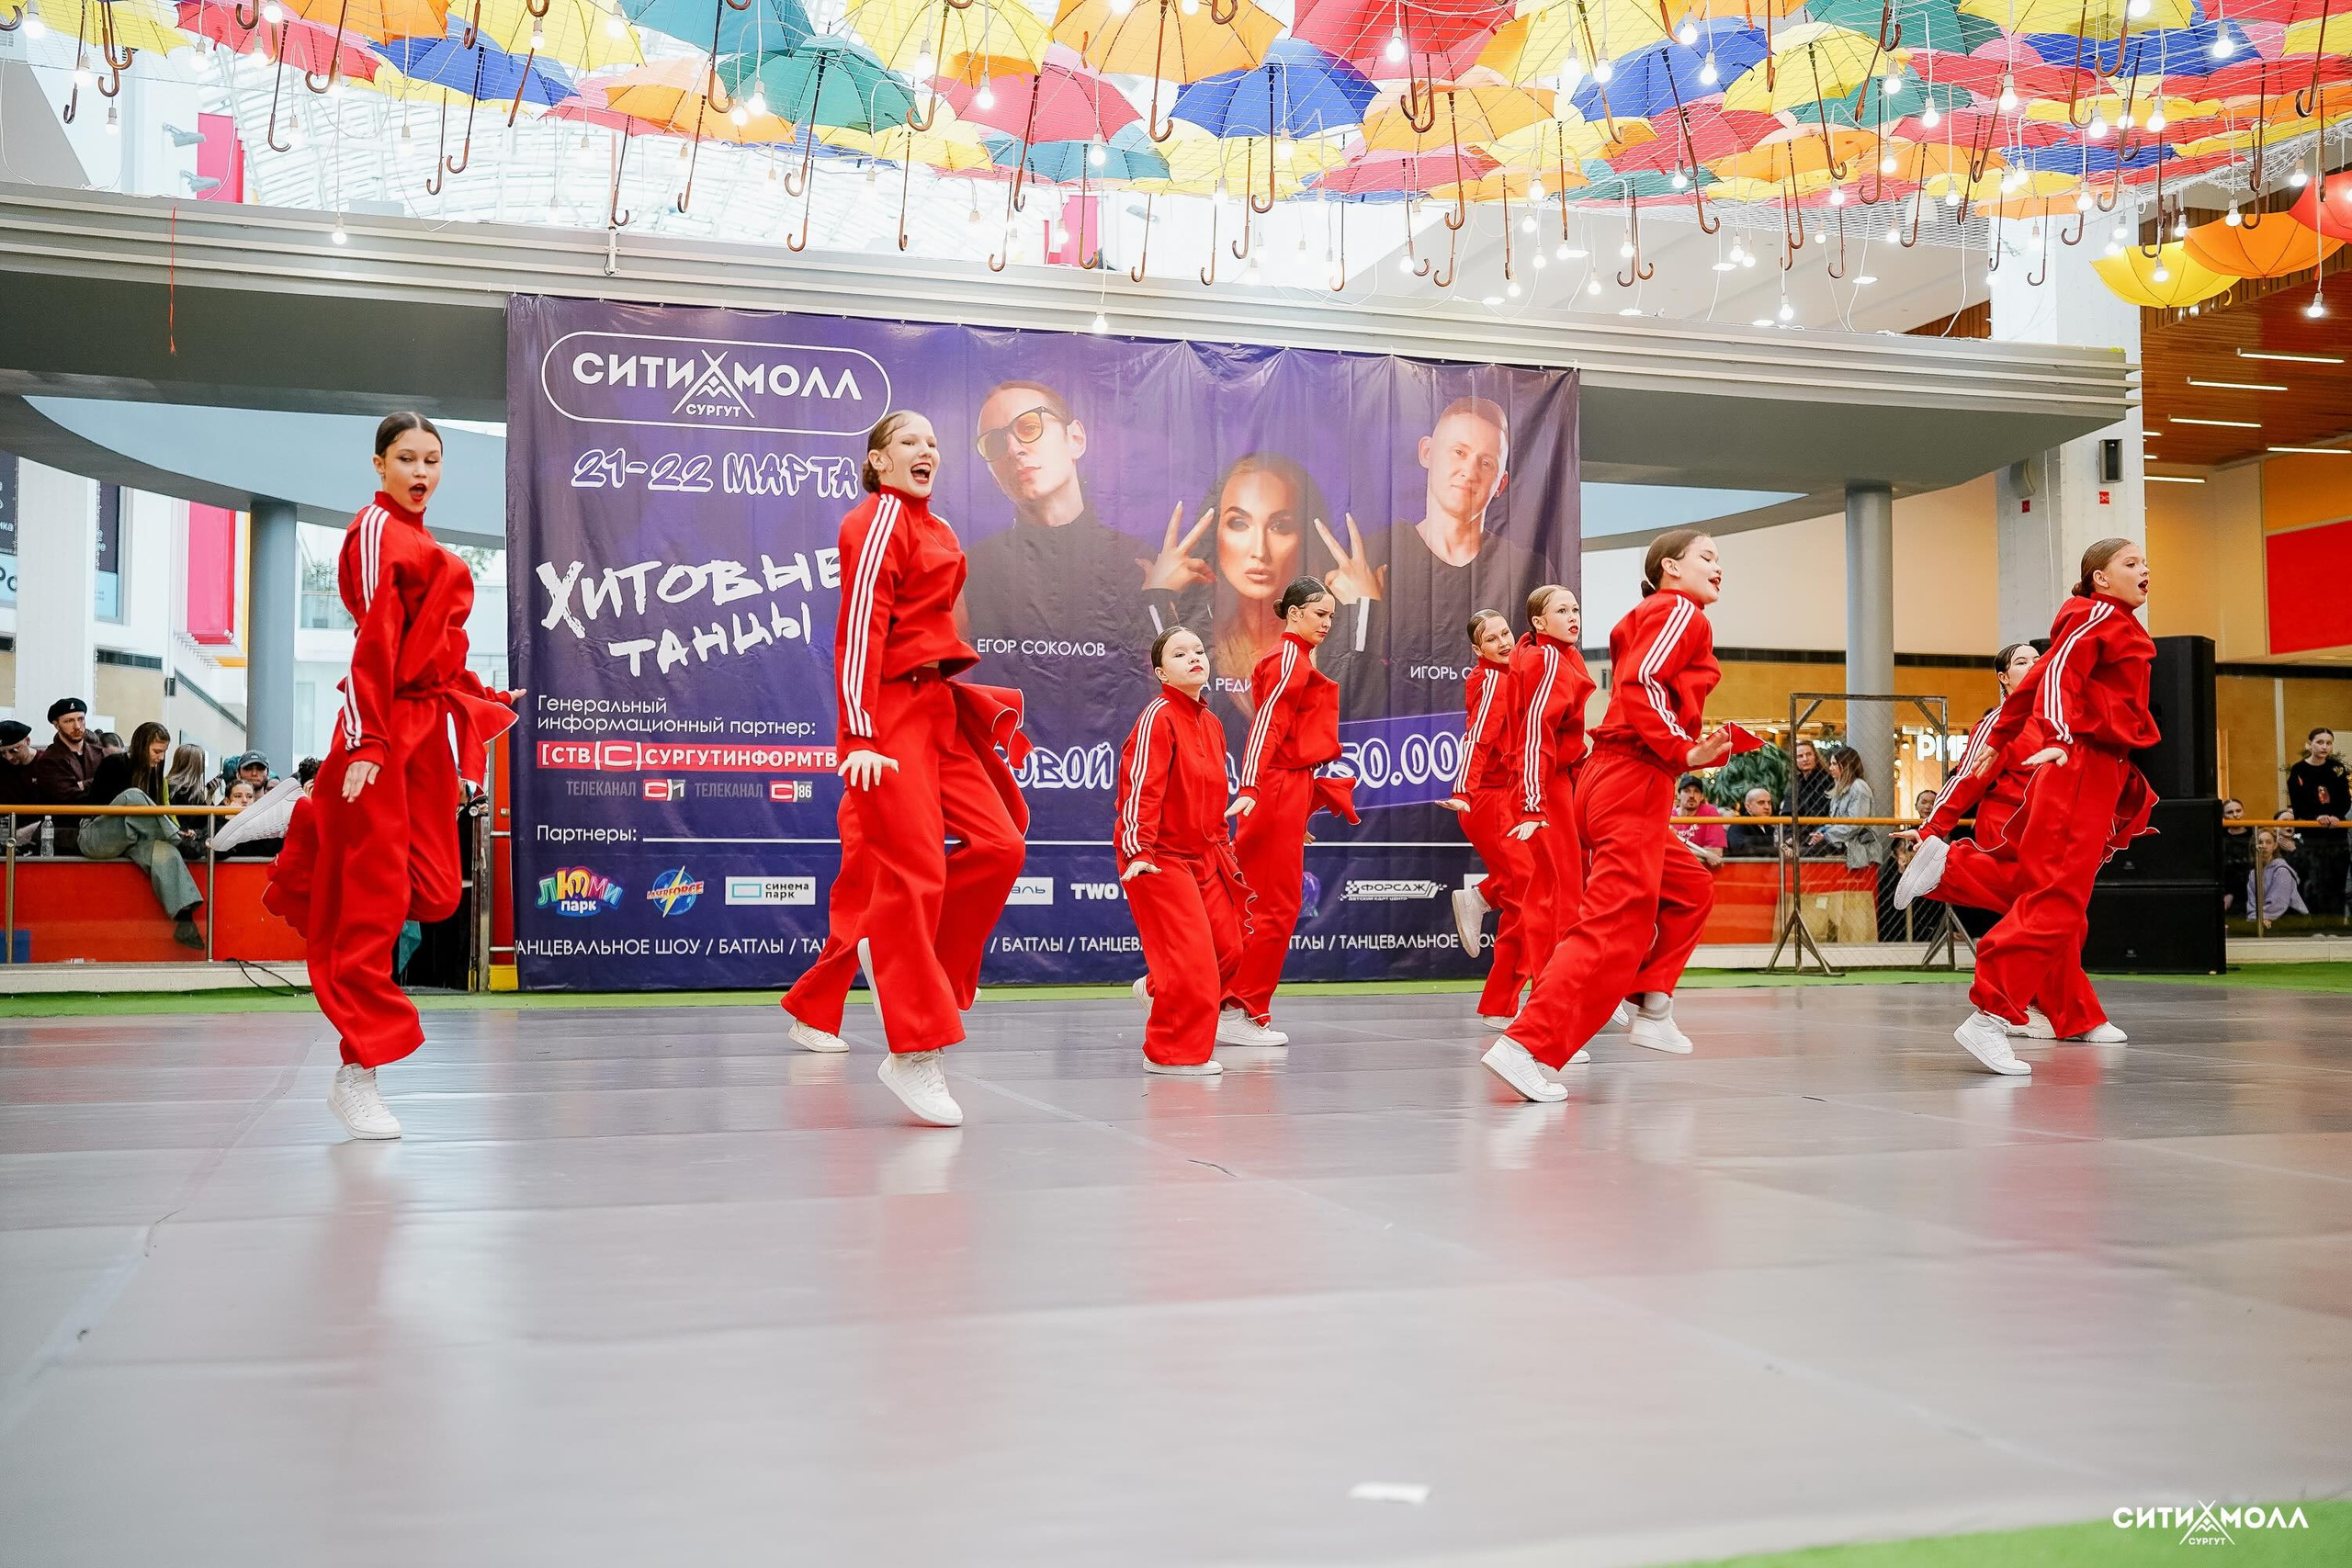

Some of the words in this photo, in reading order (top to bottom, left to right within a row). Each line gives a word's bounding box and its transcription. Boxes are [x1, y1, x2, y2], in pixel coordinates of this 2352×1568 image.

[572, 352, 695, 389] СИТИ
[734, 362, 863, 400] МОЛЛ
[685, 403, 741, 418] СУРГУТ
[571, 447, 713, 492] 21-22
[723, 452, 859, 500] МАРТА
[536, 547, 841, 638] ХИТОВЫЕ
[608, 601, 811, 677] ТАНЦЫ
[977, 639, 1016, 654] ЕГОР
[1021, 640, 1105, 657] СОКОЛОВ
[1410, 665, 1458, 680] ИГОРЬ
[537, 695, 667, 716] Генеральный
[537, 715, 724, 735] информационный
[729, 720, 817, 738] партнер:
[566, 781, 637, 796] ТЕЛЕКАНАЛ
[695, 783, 763, 798] ТЕЛЕКАНАЛ
[537, 825, 637, 845] Партнеры:
[537, 868, 624, 906] ЛЮМИ
[647, 880, 705, 900] LASERFORCE
[765, 882, 809, 891] синема
[765, 891, 795, 900] парк
[1011, 886, 1046, 895] аль
[1070, 883, 1119, 900] TWO
[1361, 883, 1427, 892] ФОРСАЖ
[561, 900, 597, 914] парк
[515, 939, 650, 957] АНЦЕВАЛЬНОЕ
[655, 939, 701, 954] ШОУ
[718, 939, 784, 954] БАТТЛЫ
[1002, 937, 1063, 953] БАТТЛЫ
[1339, 933, 1458, 951] ТАНЦЕВАЛЬНОЕ
